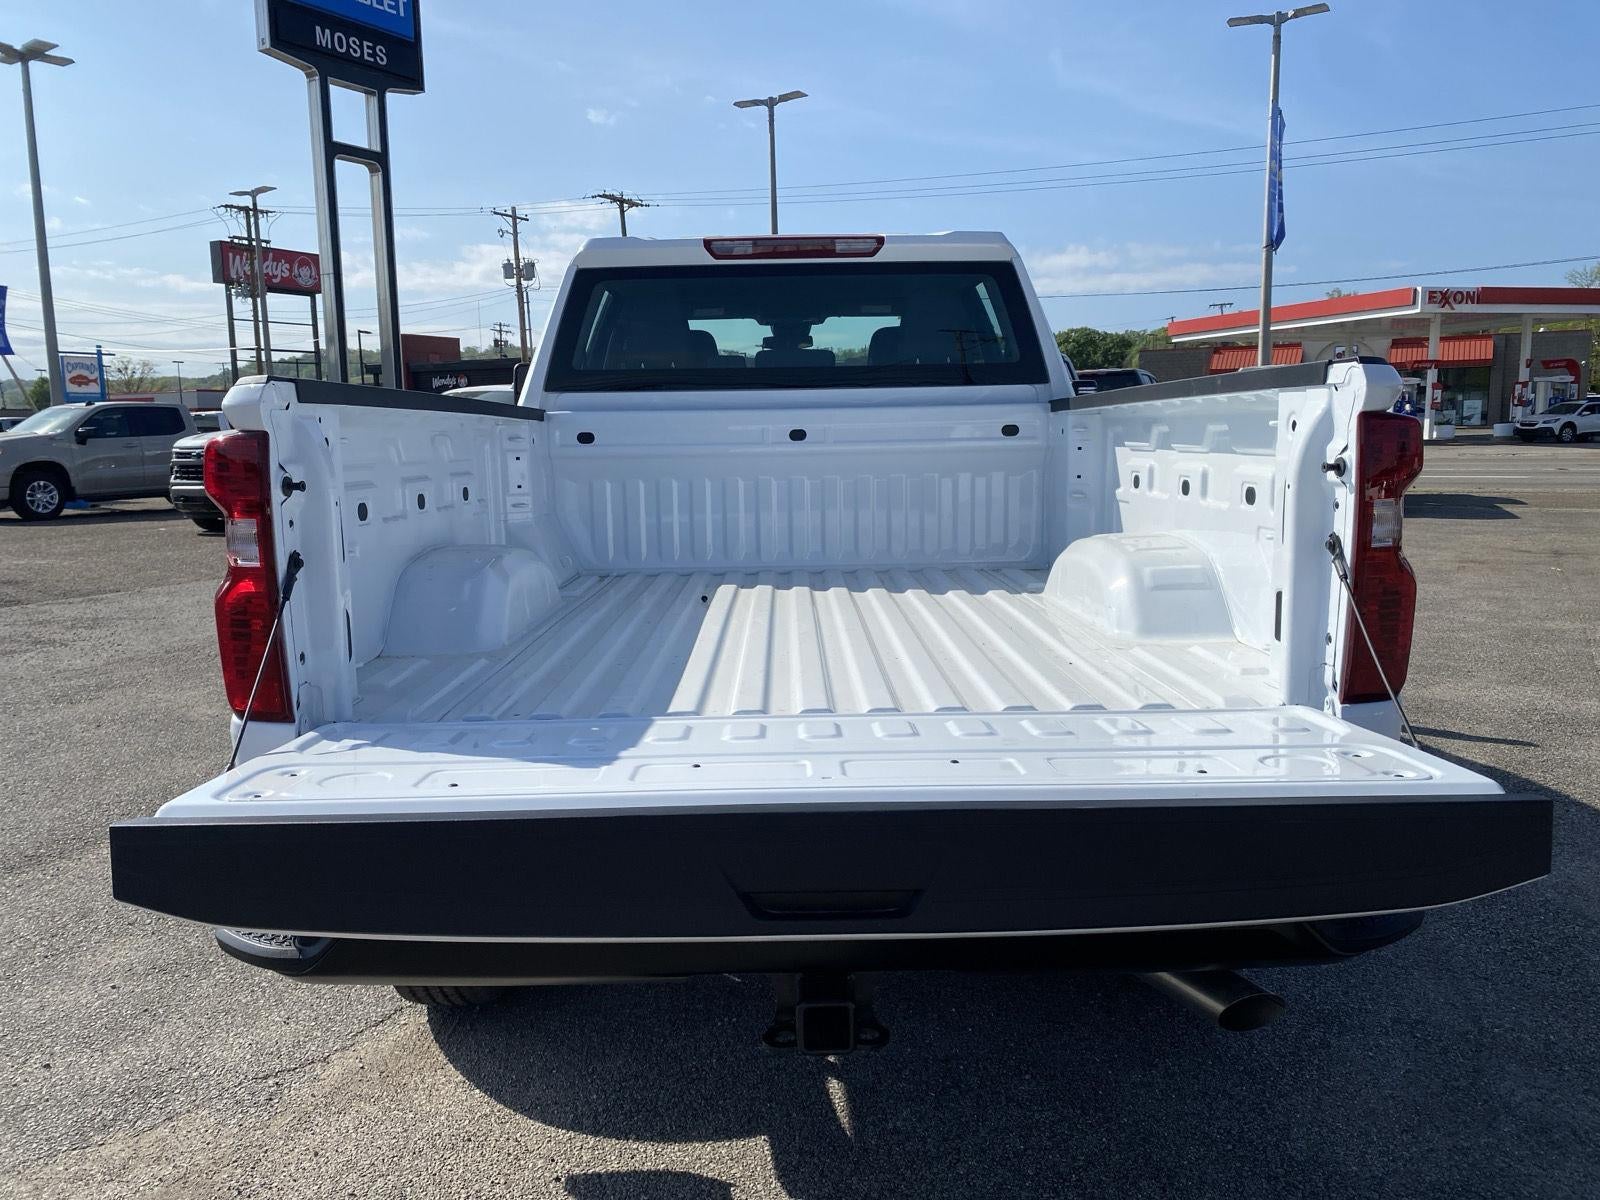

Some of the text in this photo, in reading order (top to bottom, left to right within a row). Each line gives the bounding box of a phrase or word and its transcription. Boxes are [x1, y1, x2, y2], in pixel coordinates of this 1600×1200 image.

[315, 25, 387, 65] MOSES
[228, 251, 290, 283] Wedy's
[1427, 288, 1476, 310] EXXON
